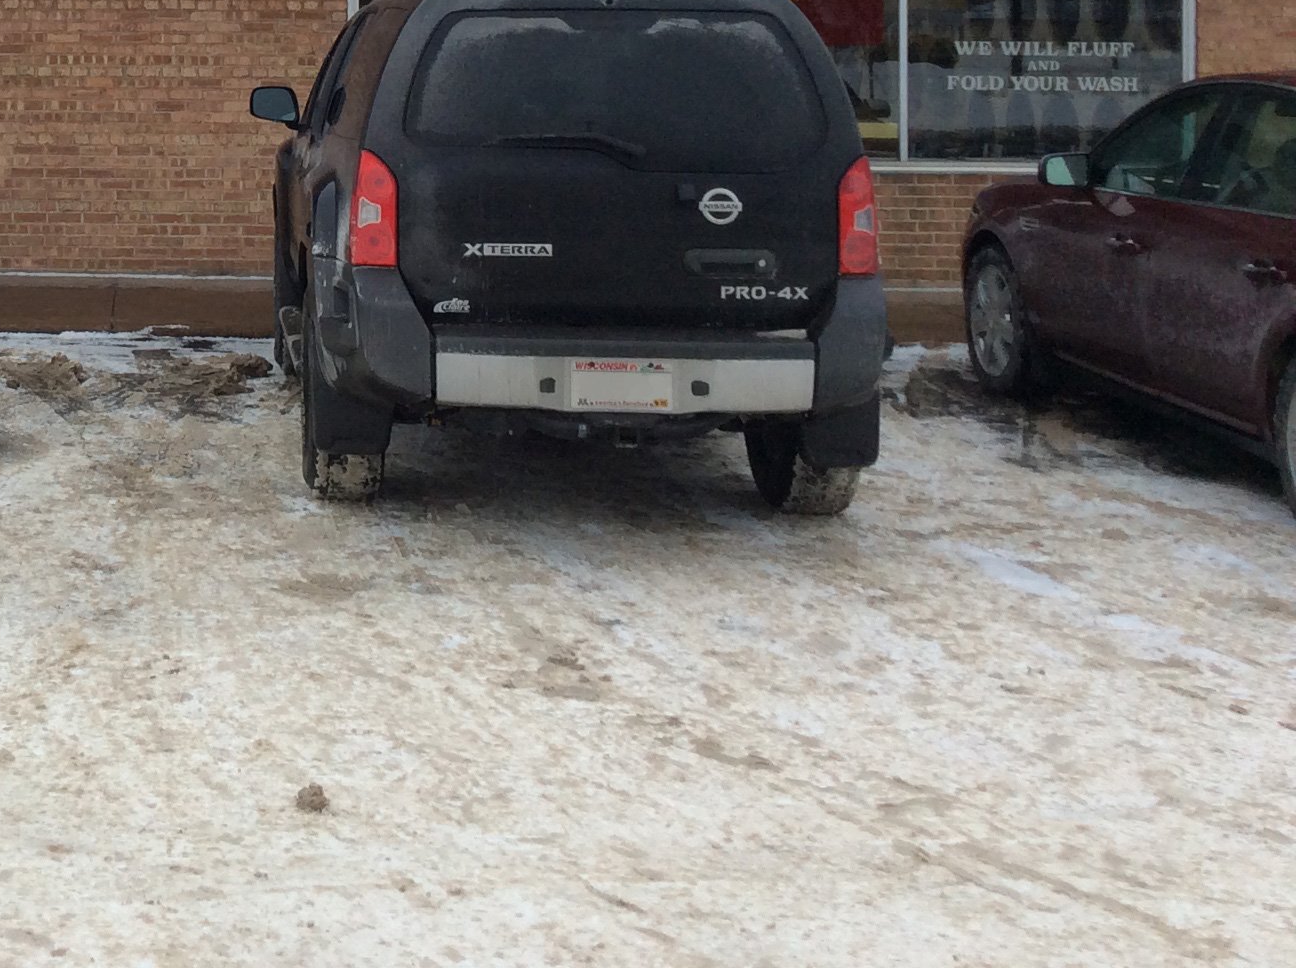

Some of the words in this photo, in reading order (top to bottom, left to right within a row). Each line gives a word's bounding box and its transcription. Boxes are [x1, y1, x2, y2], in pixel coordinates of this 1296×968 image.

[954, 40, 993, 56] WE
[999, 41, 1059, 57] WILL
[1067, 41, 1136, 57] FLUFF
[1027, 60, 1061, 72] AND
[946, 75, 1005, 91] FOLD
[1010, 75, 1070, 92] YOUR
[1076, 76, 1140, 93] WASH
[463, 242, 553, 257] XTERRA
[720, 285, 809, 300] PRO-4X
[575, 361, 628, 370] WISCONSIN
